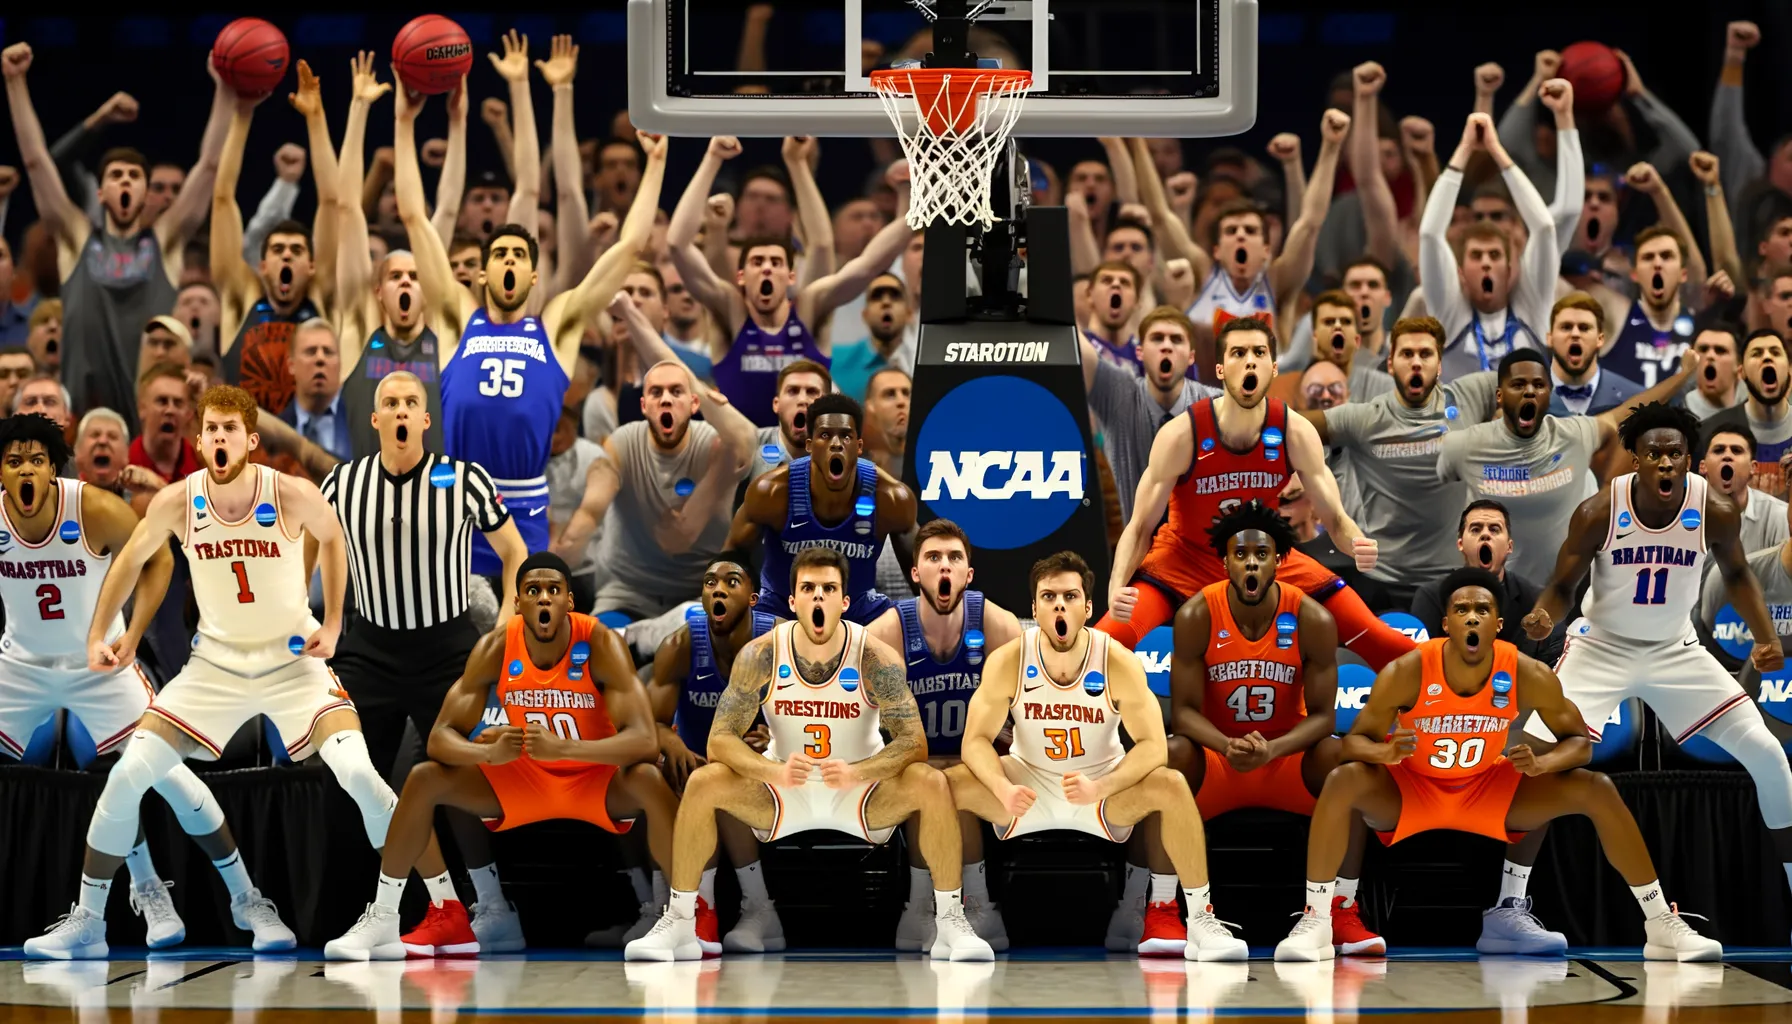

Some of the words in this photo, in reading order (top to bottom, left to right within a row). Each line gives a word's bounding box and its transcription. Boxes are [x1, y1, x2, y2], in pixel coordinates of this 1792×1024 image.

[944, 341, 1049, 362] STAROTION
[479, 357, 526, 398] 35
[920, 450, 1084, 501] NCAA
[231, 560, 255, 603] 1
[1632, 567, 1669, 605] 11
[35, 583, 65, 620] 2
[924, 700, 967, 738] 10
[1226, 685, 1275, 721] 43
[803, 724, 831, 759] 3
[1043, 727, 1086, 761] 31
[1428, 737, 1486, 769] 30
